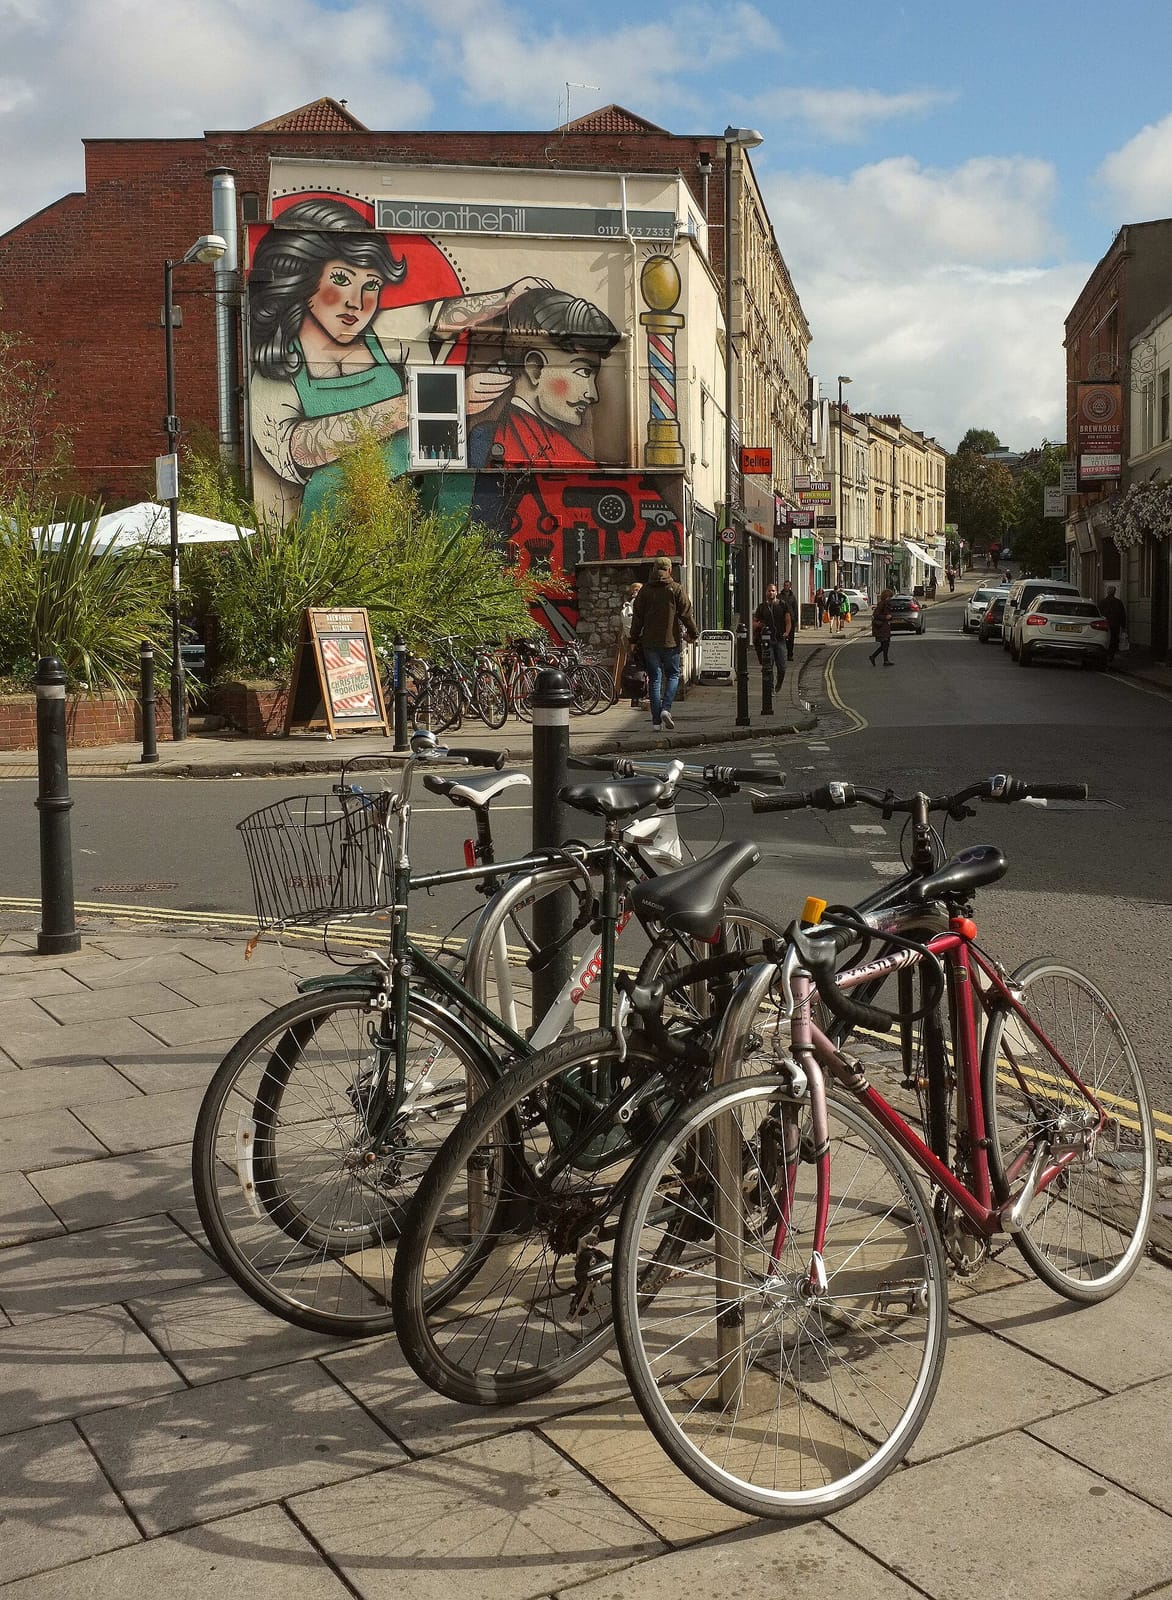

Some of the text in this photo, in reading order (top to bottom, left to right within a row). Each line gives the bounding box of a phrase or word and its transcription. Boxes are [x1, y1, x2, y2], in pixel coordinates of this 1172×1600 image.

[379, 203, 526, 232] haironthehill
[598, 225, 619, 235] 0117
[646, 227, 670, 237] 7333
[723, 531, 733, 539] 20
[331, 673, 369, 689] CHRISTMAS
[334, 681, 369, 695] BOOKINGS
